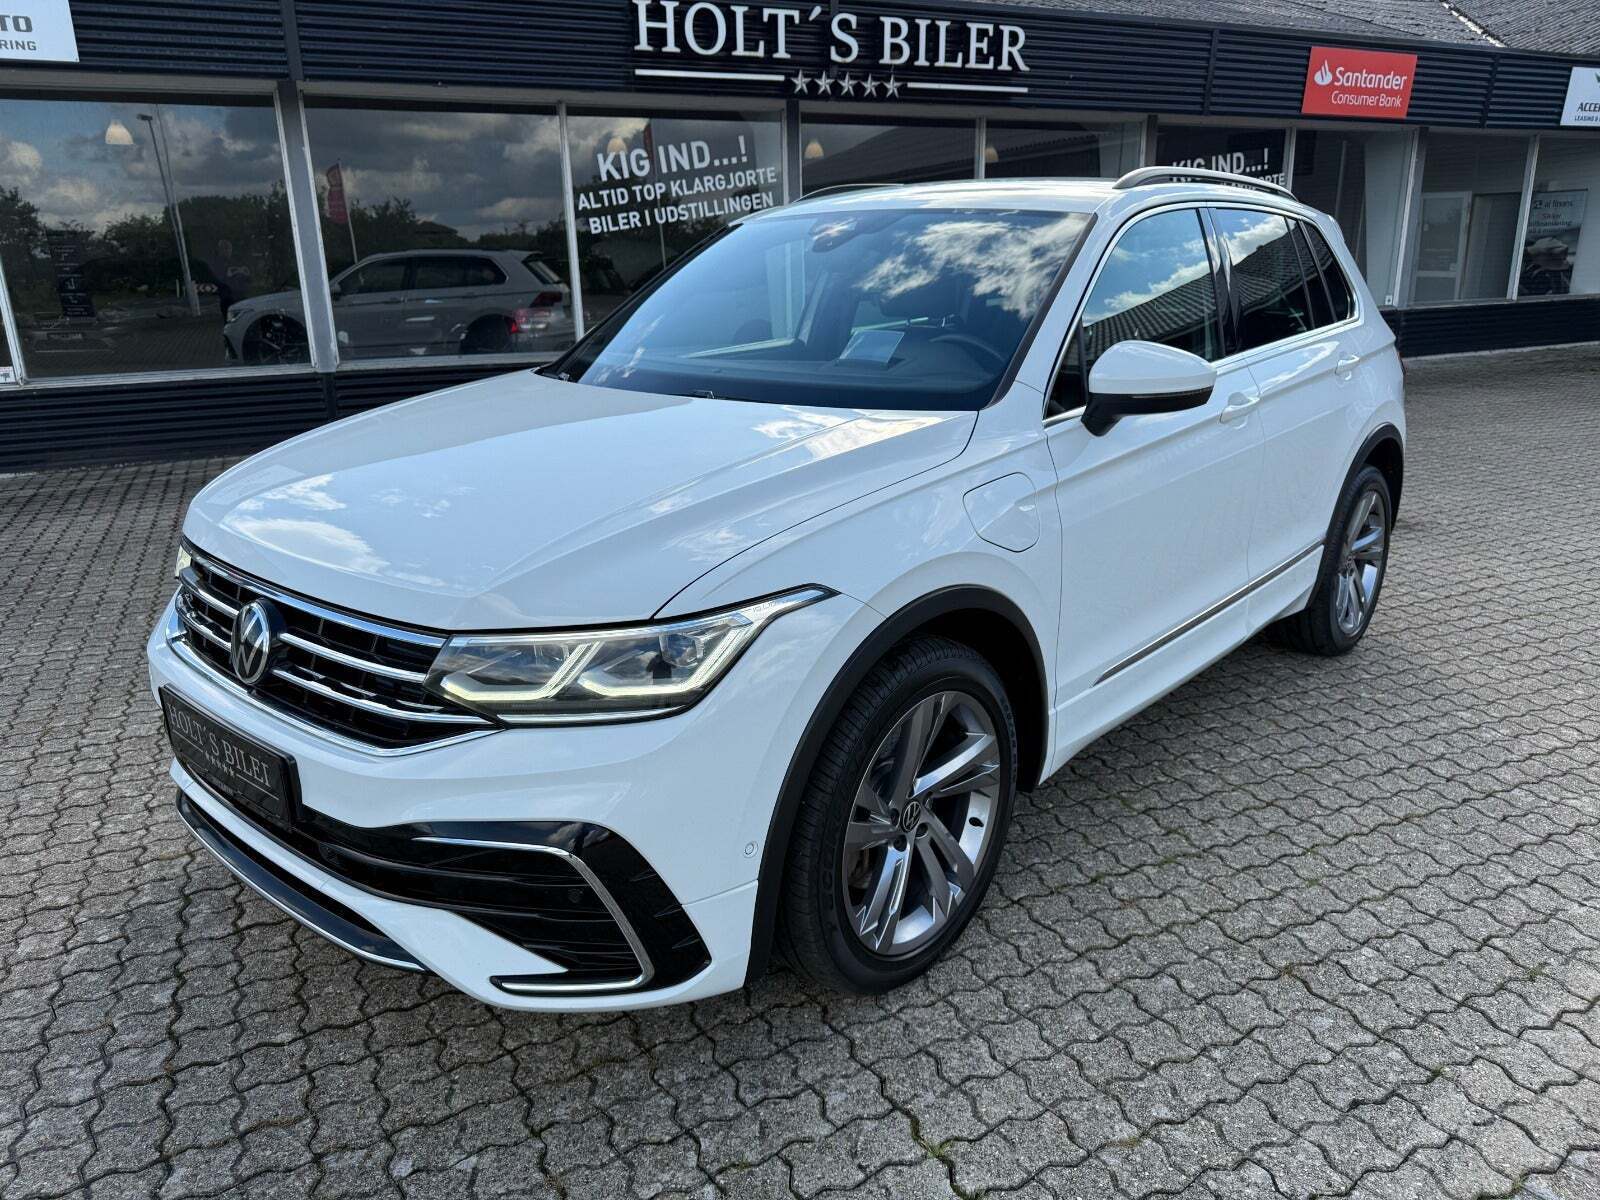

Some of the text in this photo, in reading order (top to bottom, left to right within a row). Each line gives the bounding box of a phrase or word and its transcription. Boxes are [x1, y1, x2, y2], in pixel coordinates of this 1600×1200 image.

[0, 40, 37, 51] RING
[878, 15, 1031, 72] BILER
[1331, 90, 1402, 108] Consumer Bank
[1333, 66, 1408, 90] Santander
[597, 135, 748, 182] KIG IND...!
[578, 167, 777, 211] ALTID TOP KLARGJORTE
[589, 192, 775, 234] BILER I UDSTILLINGEN
